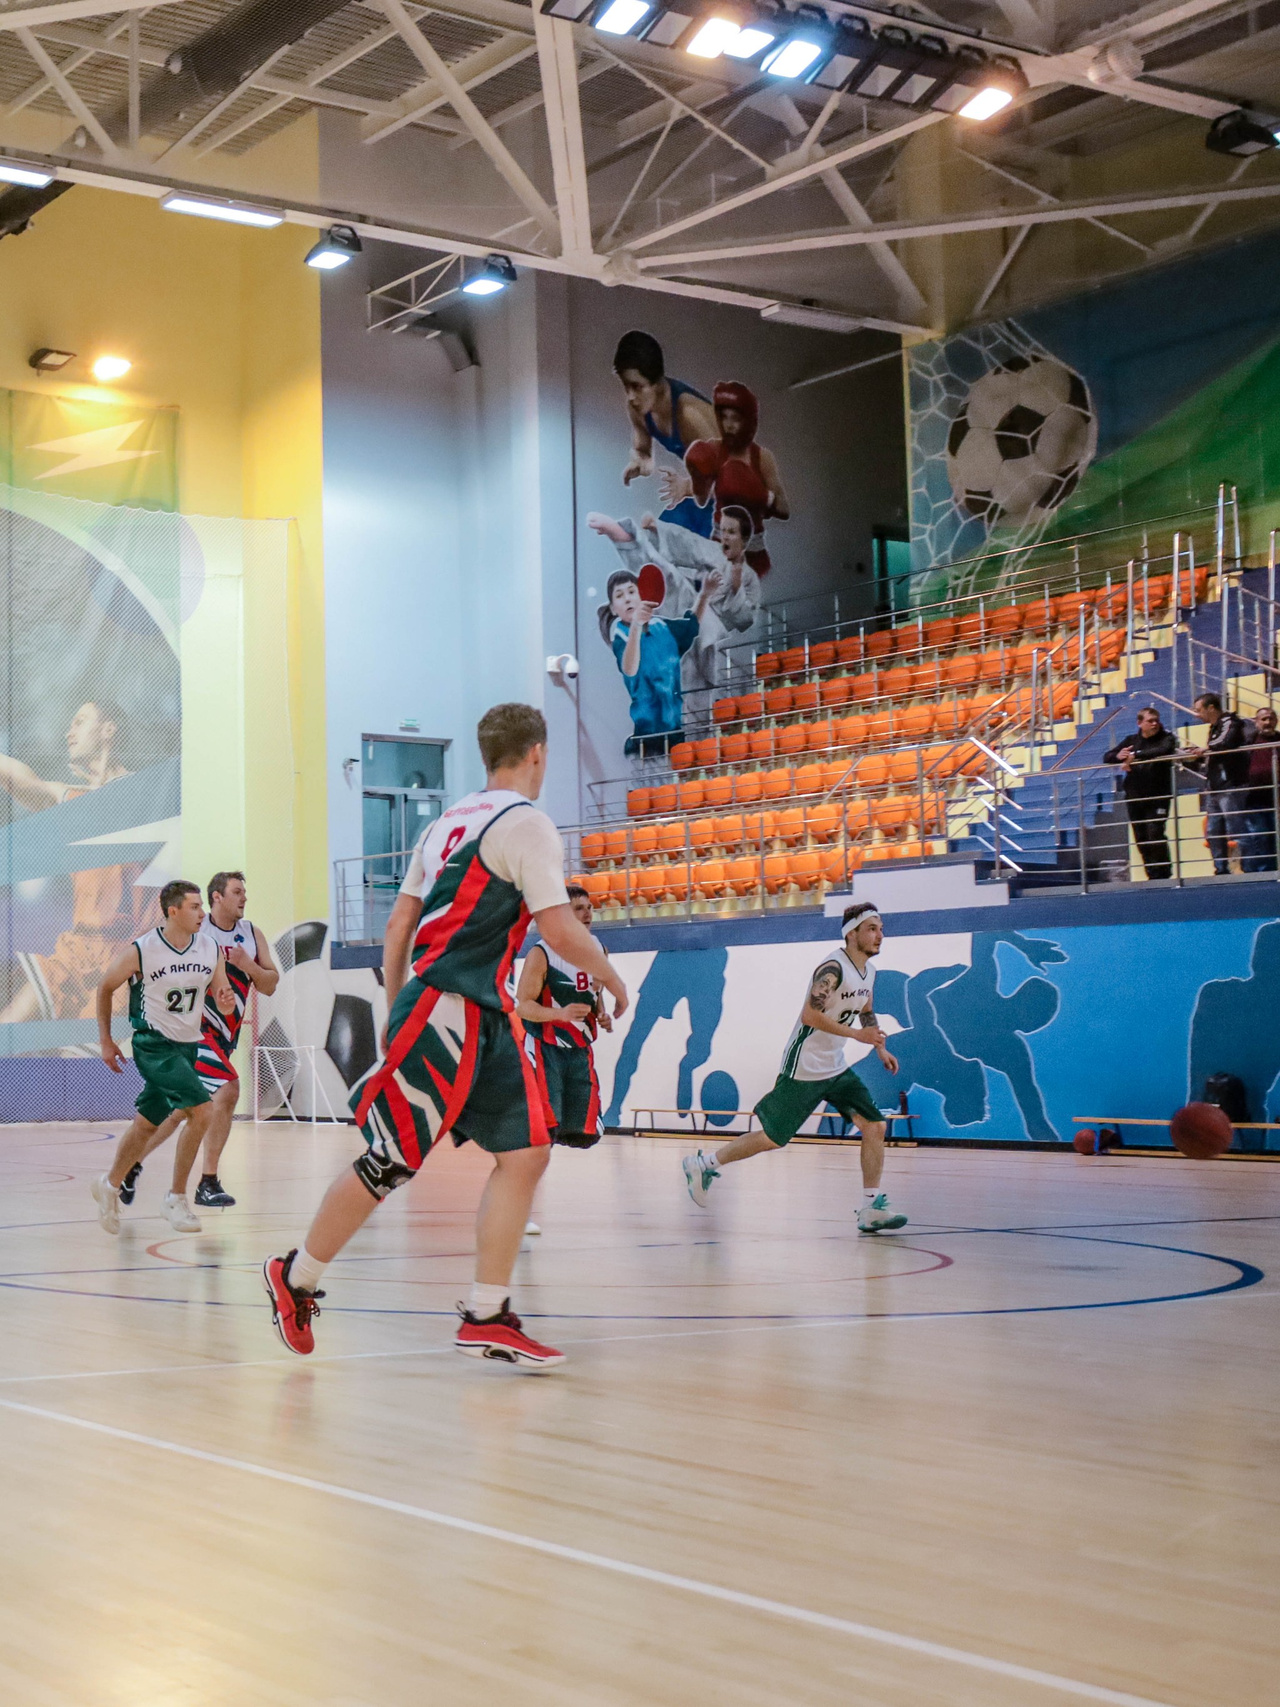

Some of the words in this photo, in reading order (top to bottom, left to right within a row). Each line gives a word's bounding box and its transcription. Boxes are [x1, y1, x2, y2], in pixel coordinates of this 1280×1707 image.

[150, 966, 167, 982] НК
[170, 963, 212, 975] ЯНГПУР
[166, 987, 198, 1013] 27
